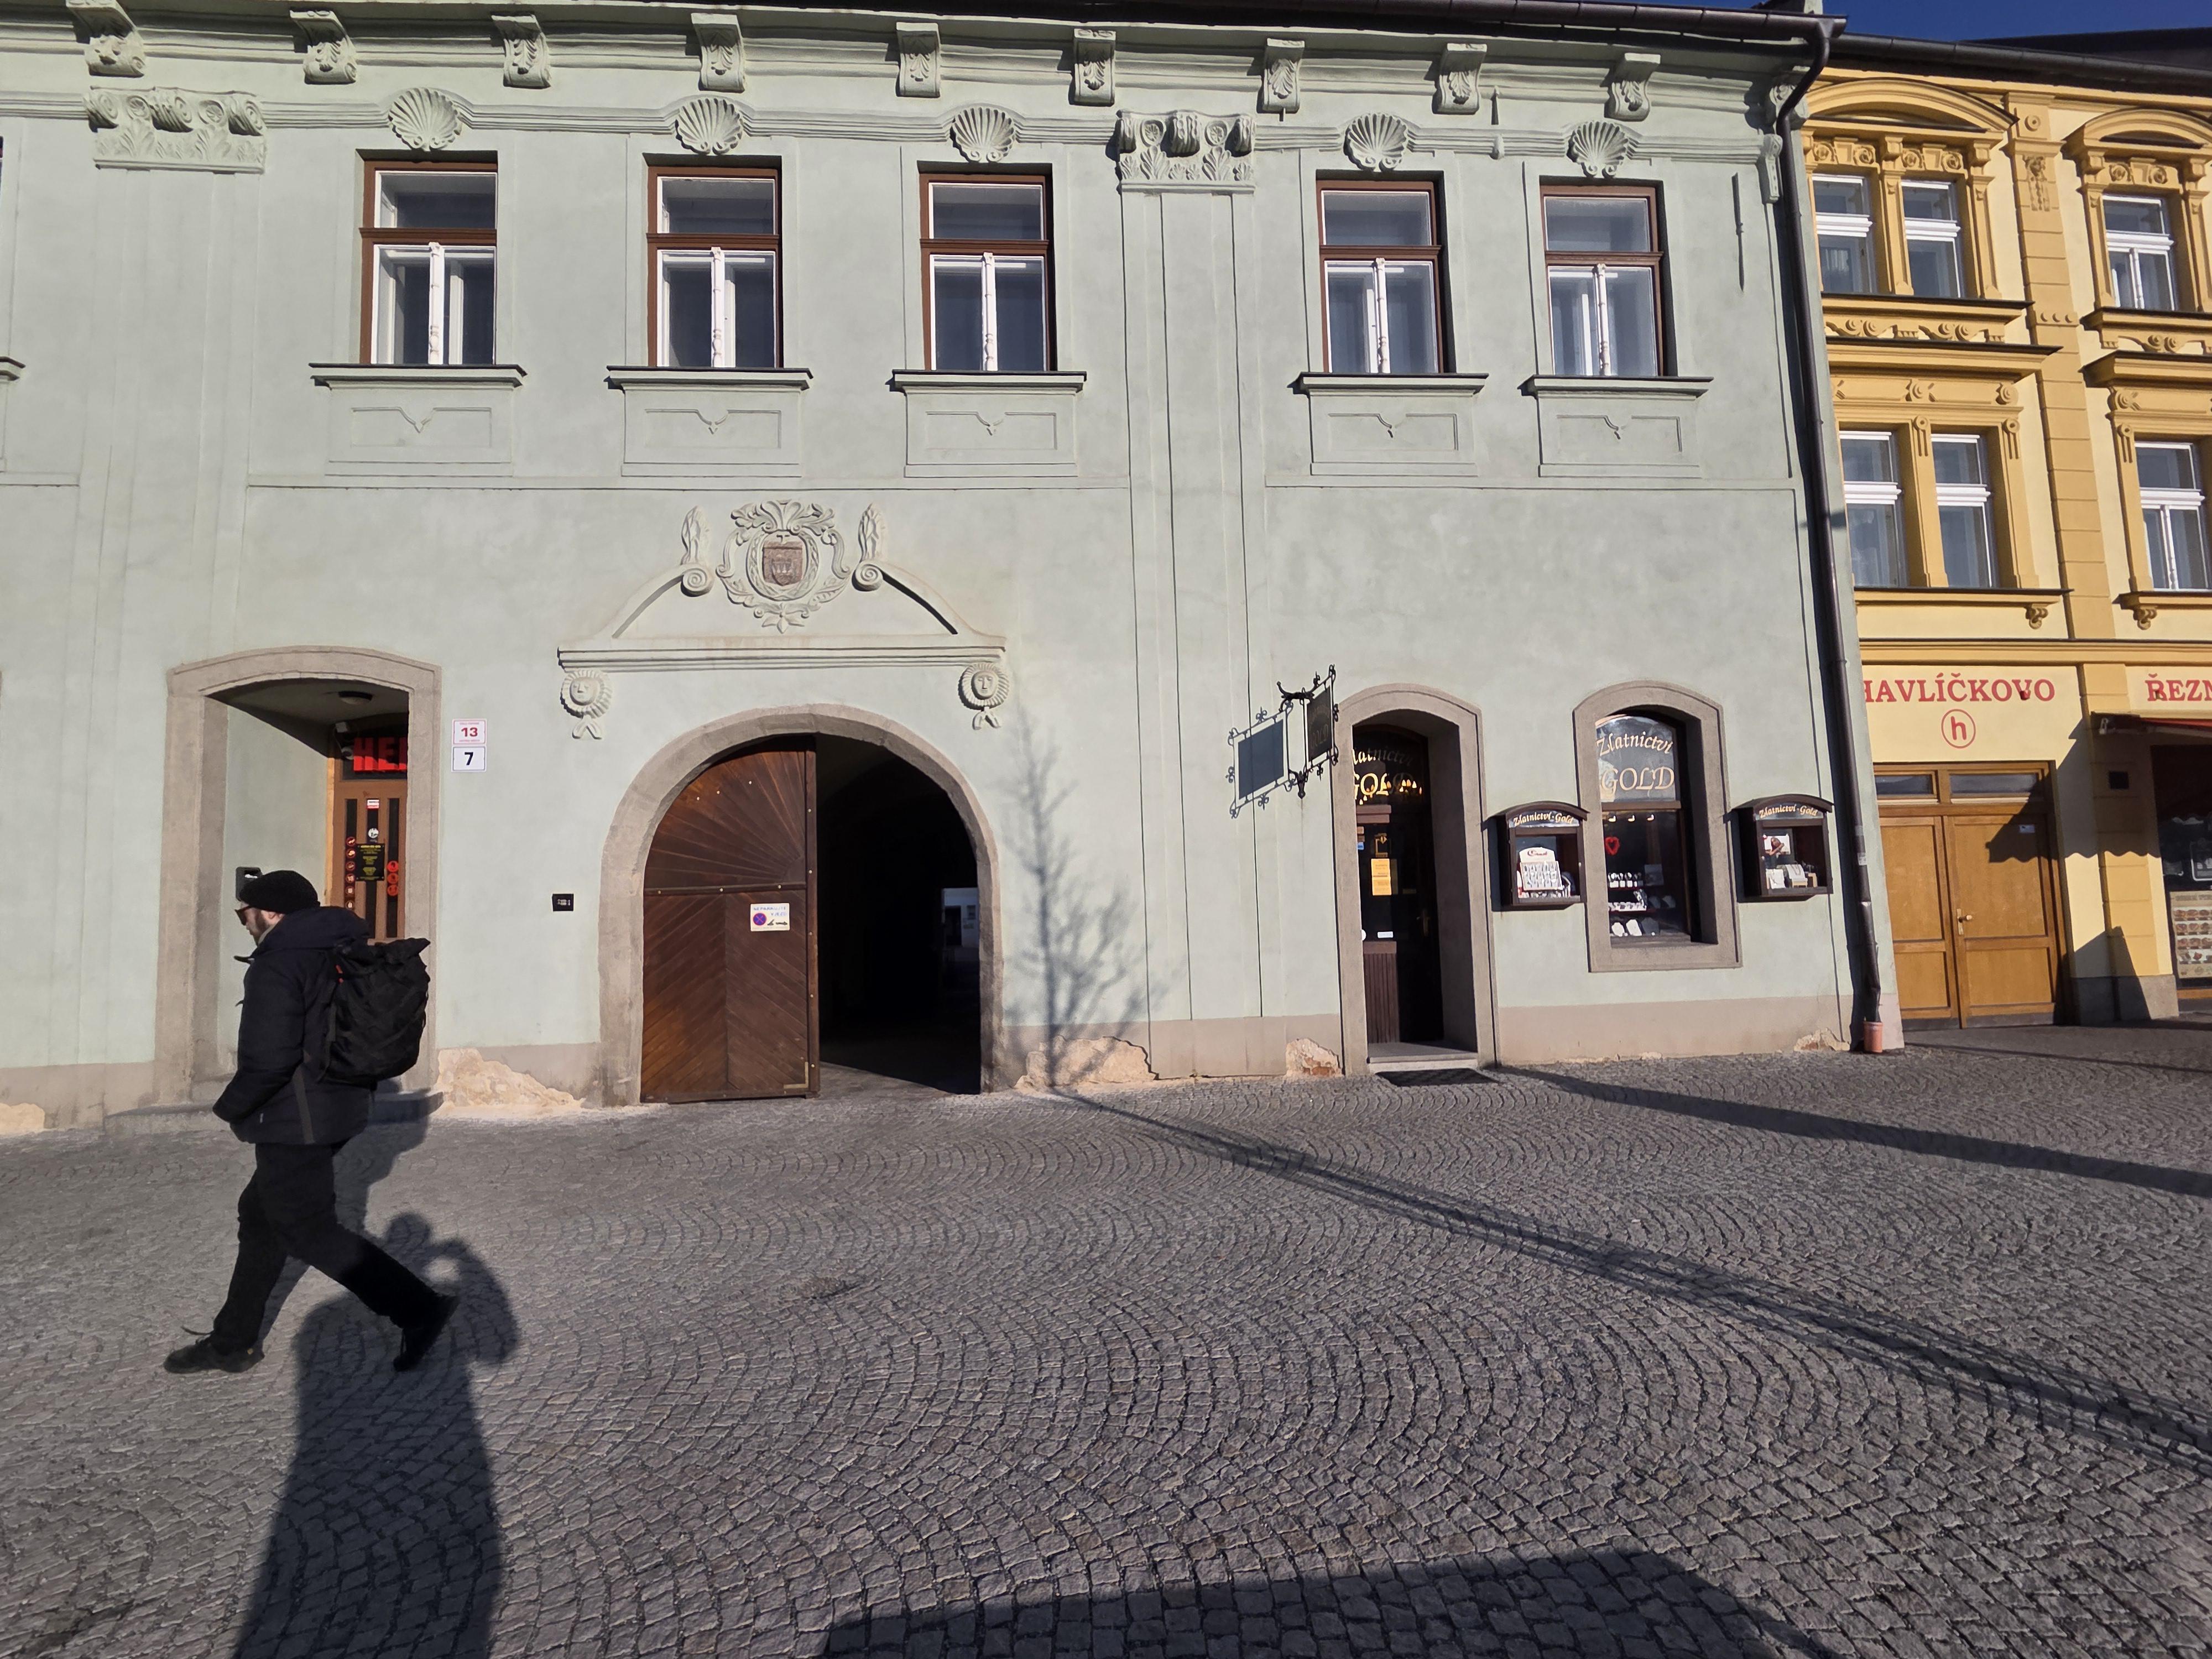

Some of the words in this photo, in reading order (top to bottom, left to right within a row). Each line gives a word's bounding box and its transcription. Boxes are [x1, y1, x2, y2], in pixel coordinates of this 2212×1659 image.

[461, 727, 478, 737] 13
[465, 752, 473, 766] 7
[1601, 766, 1674, 795] GOLD
[1799, 806, 1818, 816] Gold
[1555, 812, 1574, 823] Gold
